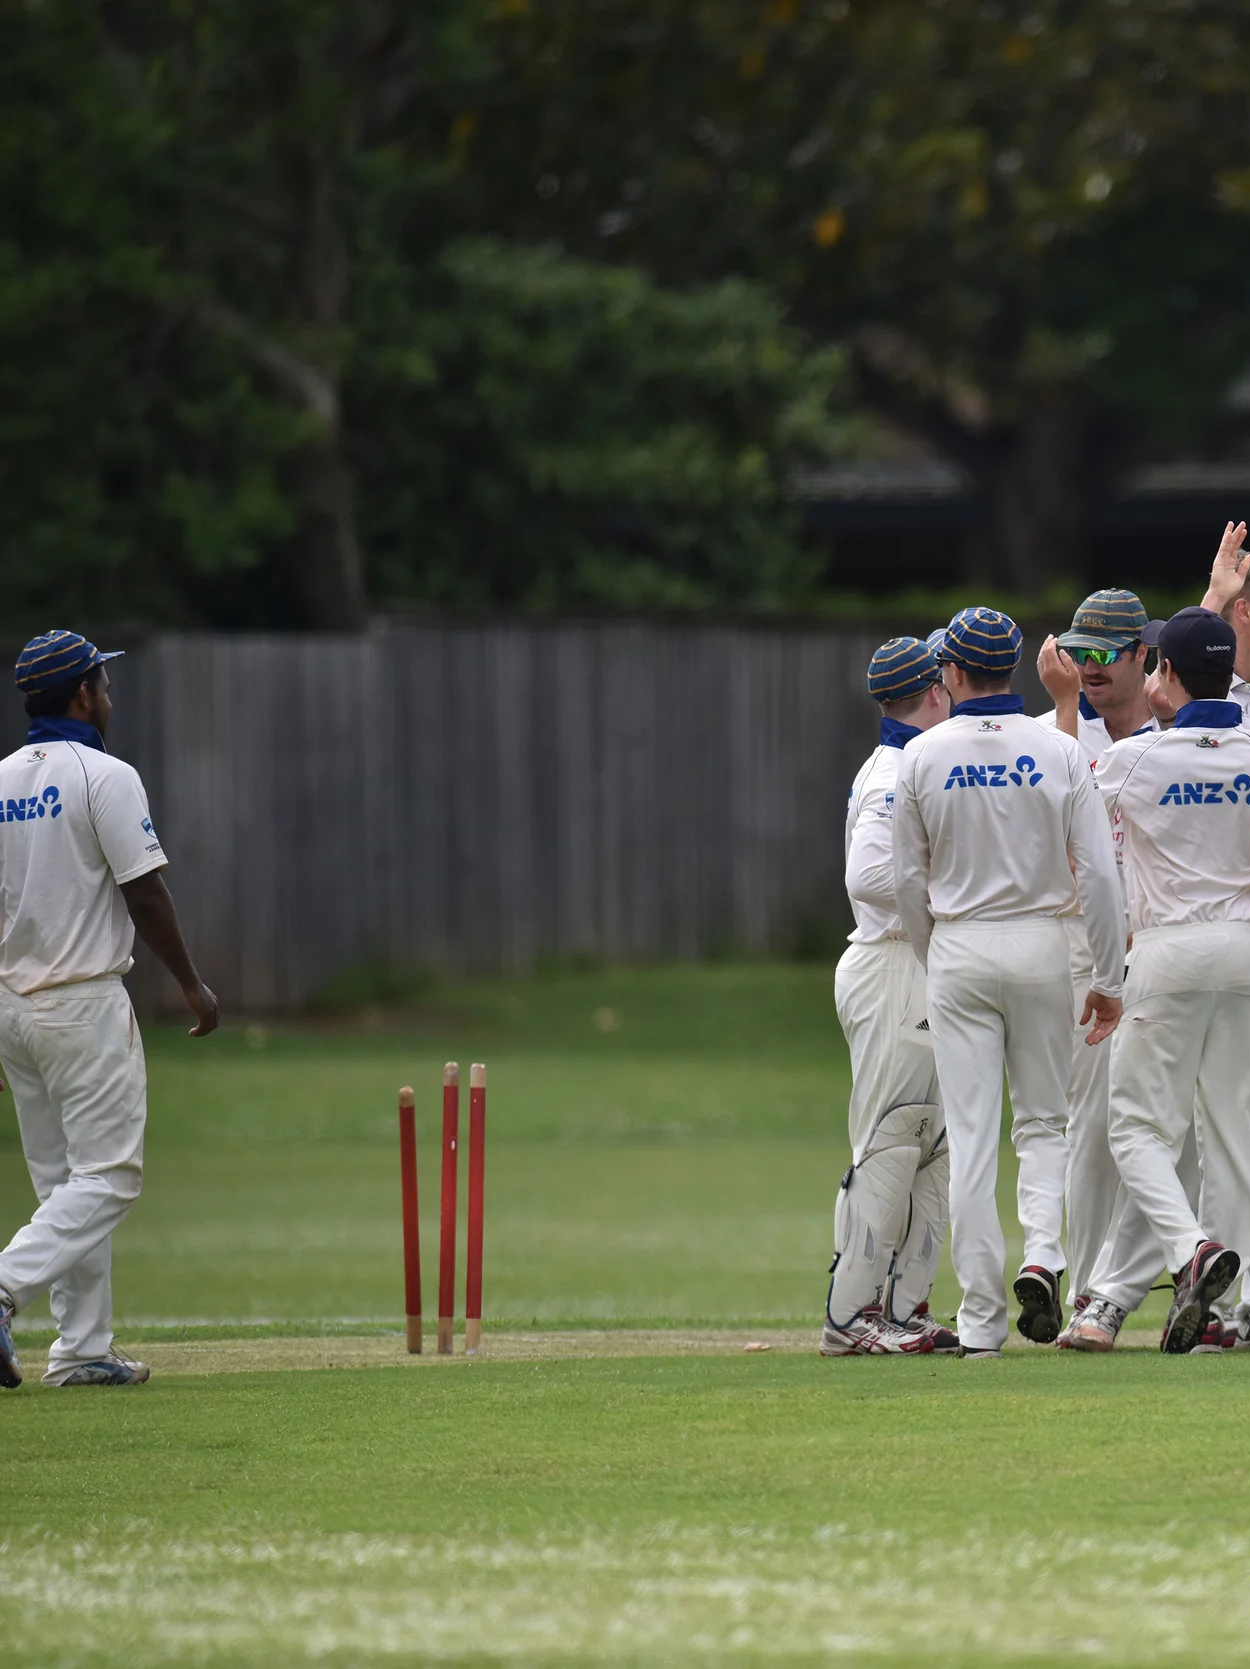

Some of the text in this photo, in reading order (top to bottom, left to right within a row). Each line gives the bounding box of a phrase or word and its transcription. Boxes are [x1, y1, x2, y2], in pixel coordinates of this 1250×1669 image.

[943, 764, 1008, 790] ANZ
[1158, 782, 1224, 806] ANZ
[0, 796, 38, 823] NZ
